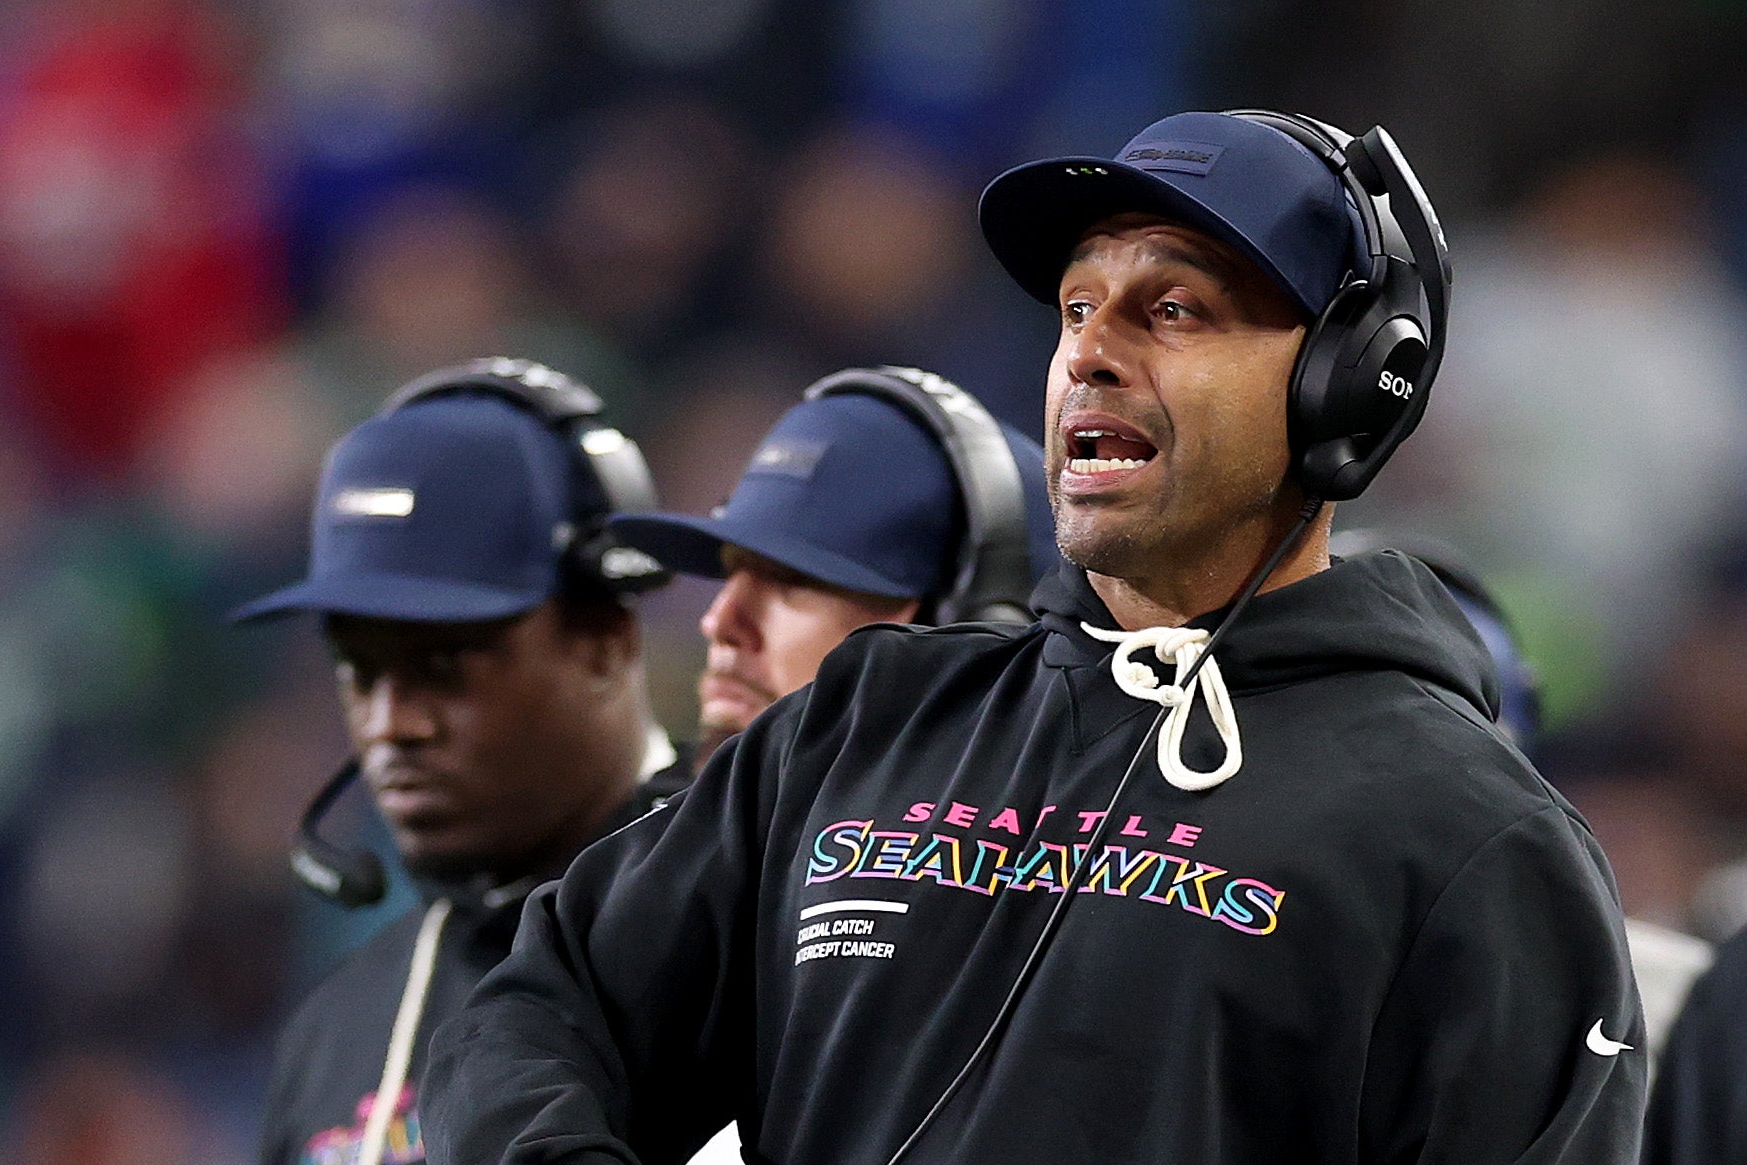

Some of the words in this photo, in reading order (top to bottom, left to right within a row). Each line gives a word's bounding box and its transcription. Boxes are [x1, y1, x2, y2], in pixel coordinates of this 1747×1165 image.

[1378, 370, 1413, 400] SON
[804, 818, 1286, 936] SEAHAWKS
[832, 920, 875, 935] CATCH
[841, 941, 895, 959] CANCER
